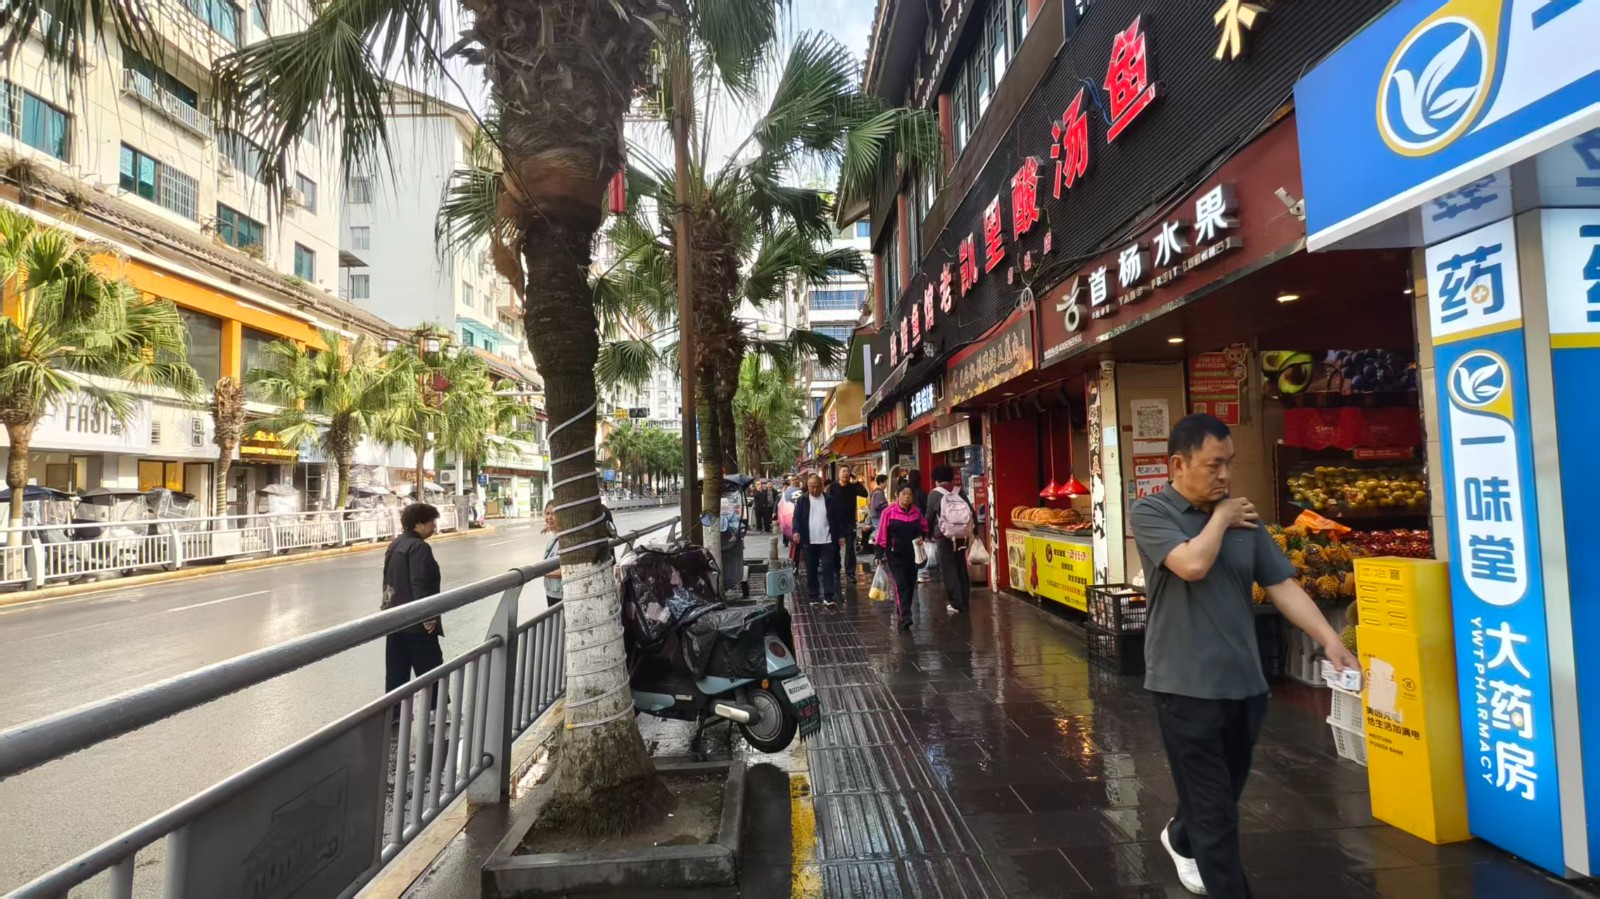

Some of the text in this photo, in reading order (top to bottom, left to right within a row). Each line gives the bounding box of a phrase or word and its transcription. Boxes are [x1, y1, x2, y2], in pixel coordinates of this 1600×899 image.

[1088, 184, 1228, 307] 首杨水果
[1436, 242, 1506, 324] 药
[1460, 433, 1518, 583] 一味堂
[1366, 717, 1421, 740] 给生活加满电
[1485, 621, 1537, 801] 大药房
